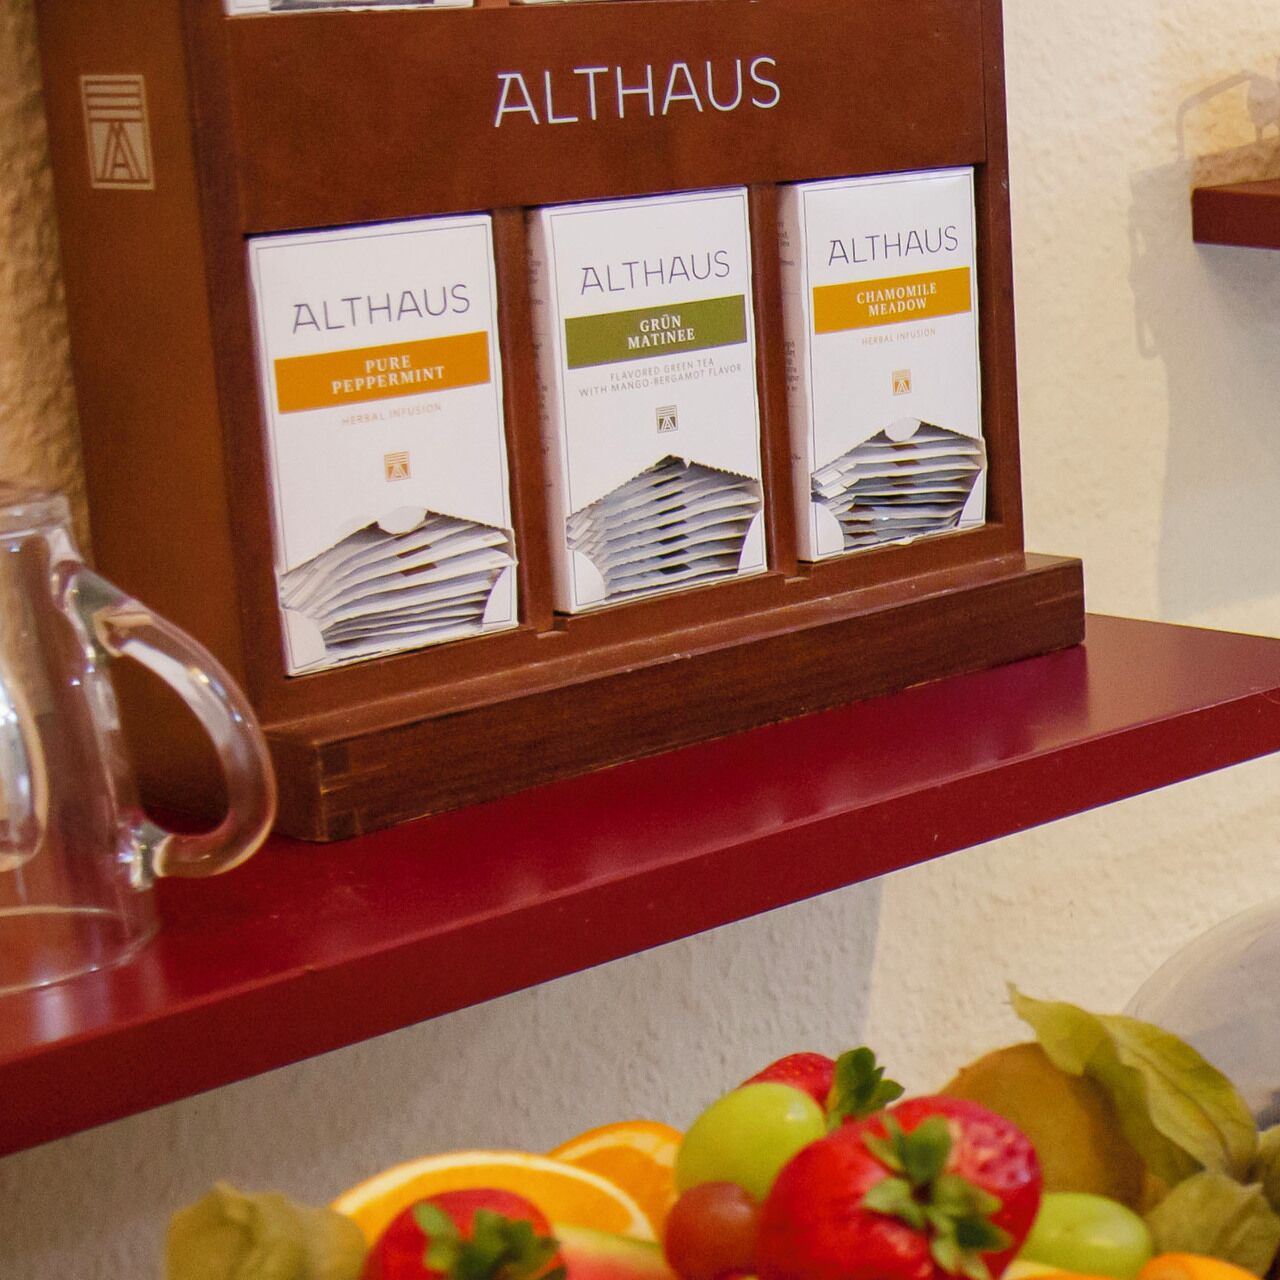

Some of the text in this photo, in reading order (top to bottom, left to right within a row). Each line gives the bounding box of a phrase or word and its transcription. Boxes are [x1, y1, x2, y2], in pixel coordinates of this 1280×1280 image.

[494, 56, 781, 128] ALTHAUS
[828, 225, 959, 267] ALTHAUS
[580, 250, 730, 296] ALTHAUS
[856, 282, 937, 305] CHAMOMILE
[292, 283, 471, 335] ALTHAUS
[868, 297, 928, 318] MEADOW
[639, 314, 682, 333] GRÜN
[627, 327, 696, 350] MATINEE
[861, 328, 937, 346] HERBAL INFUSION
[365, 354, 411, 374] PURE
[610, 357, 715, 382] FLAVORED GREEN TEA
[332, 366, 446, 395] PEPPERMINT
[578, 363, 743, 397] WITH MANGO-BERGAMOT FLAVOR
[341, 404, 442, 426] HERBAL INFUSION
